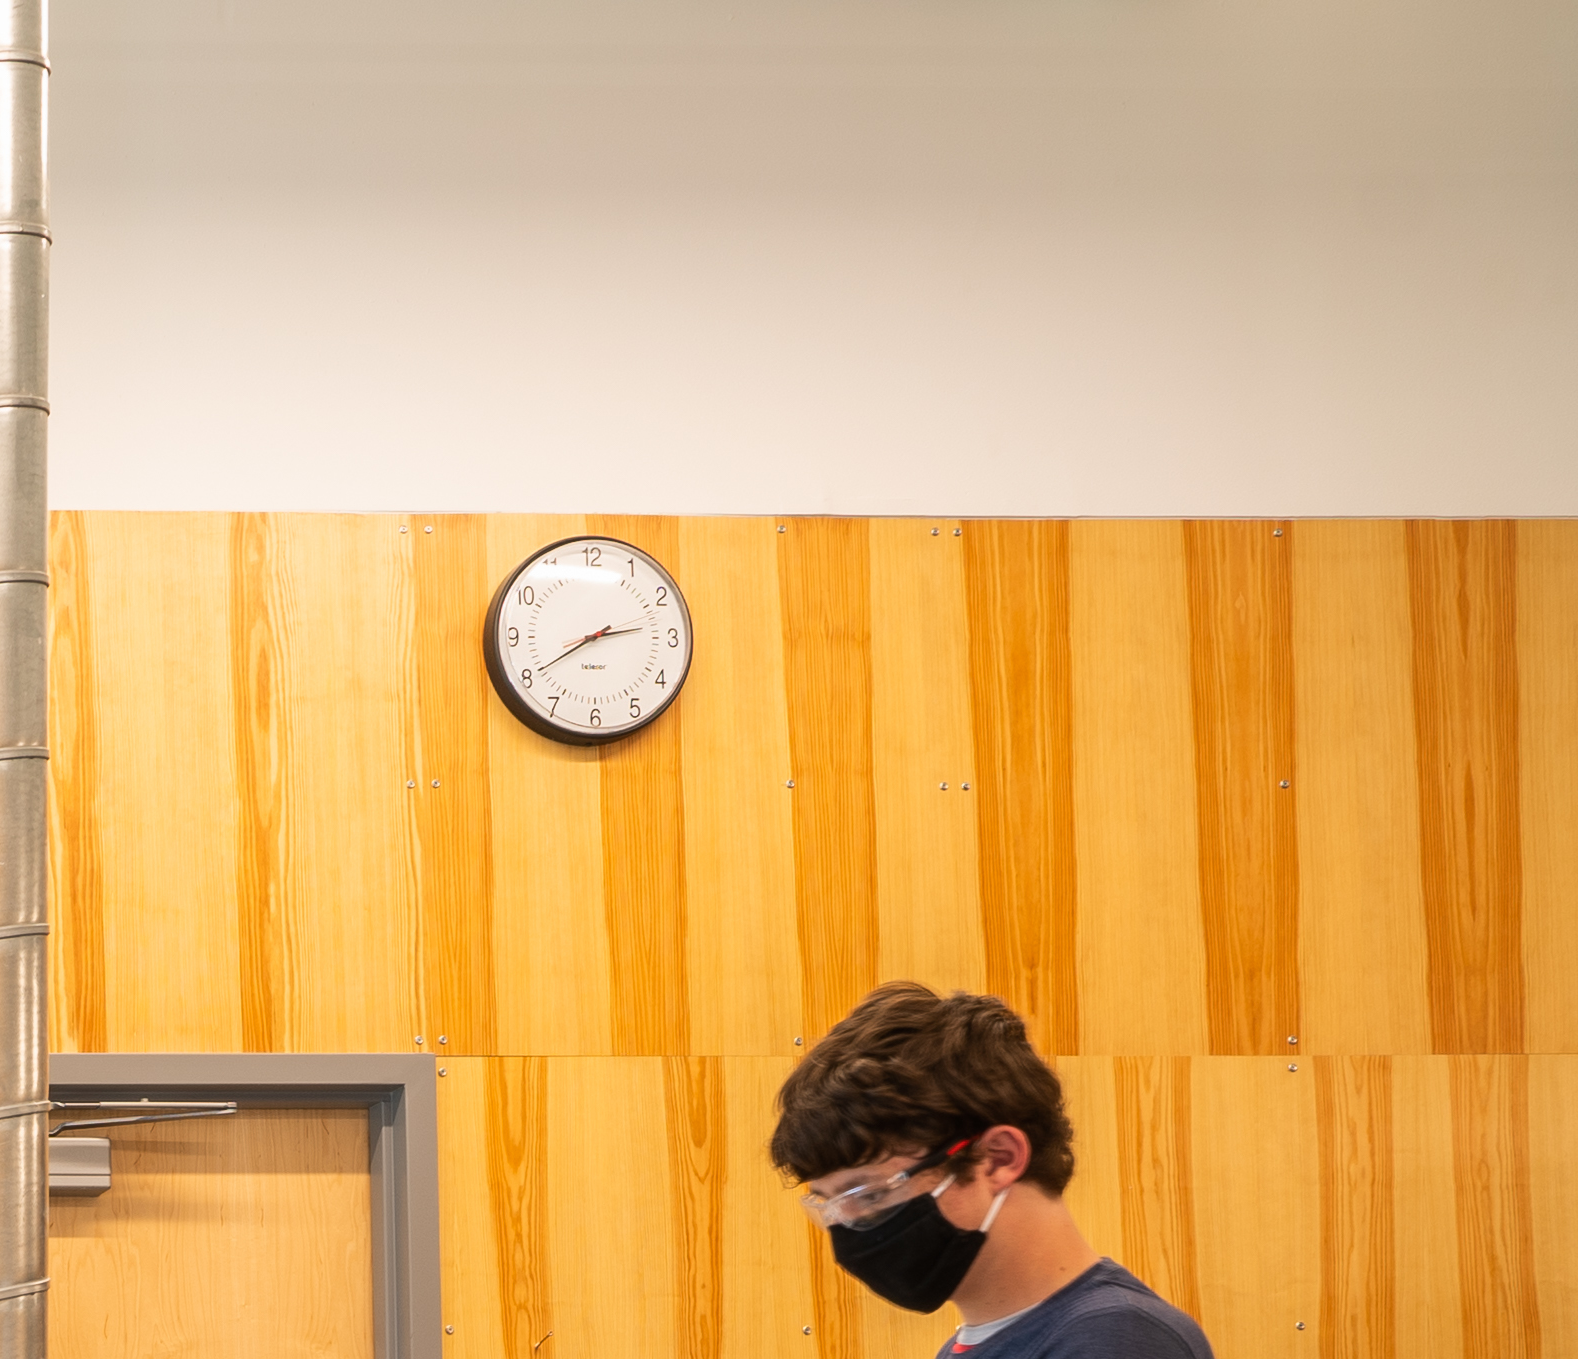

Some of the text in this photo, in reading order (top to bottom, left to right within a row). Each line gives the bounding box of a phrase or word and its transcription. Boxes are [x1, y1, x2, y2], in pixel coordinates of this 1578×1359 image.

[582, 547, 602, 567] 12
[627, 558, 635, 577] 1
[517, 586, 535, 605] 10
[656, 586, 668, 606] 2
[508, 627, 519, 647] 9
[667, 628, 679, 648] 3
[521, 669, 533, 689] 8
[655, 669, 667, 689] 4
[547, 697, 560, 718] 7
[630, 698, 641, 718] 5
[590, 708, 602, 728] 6
